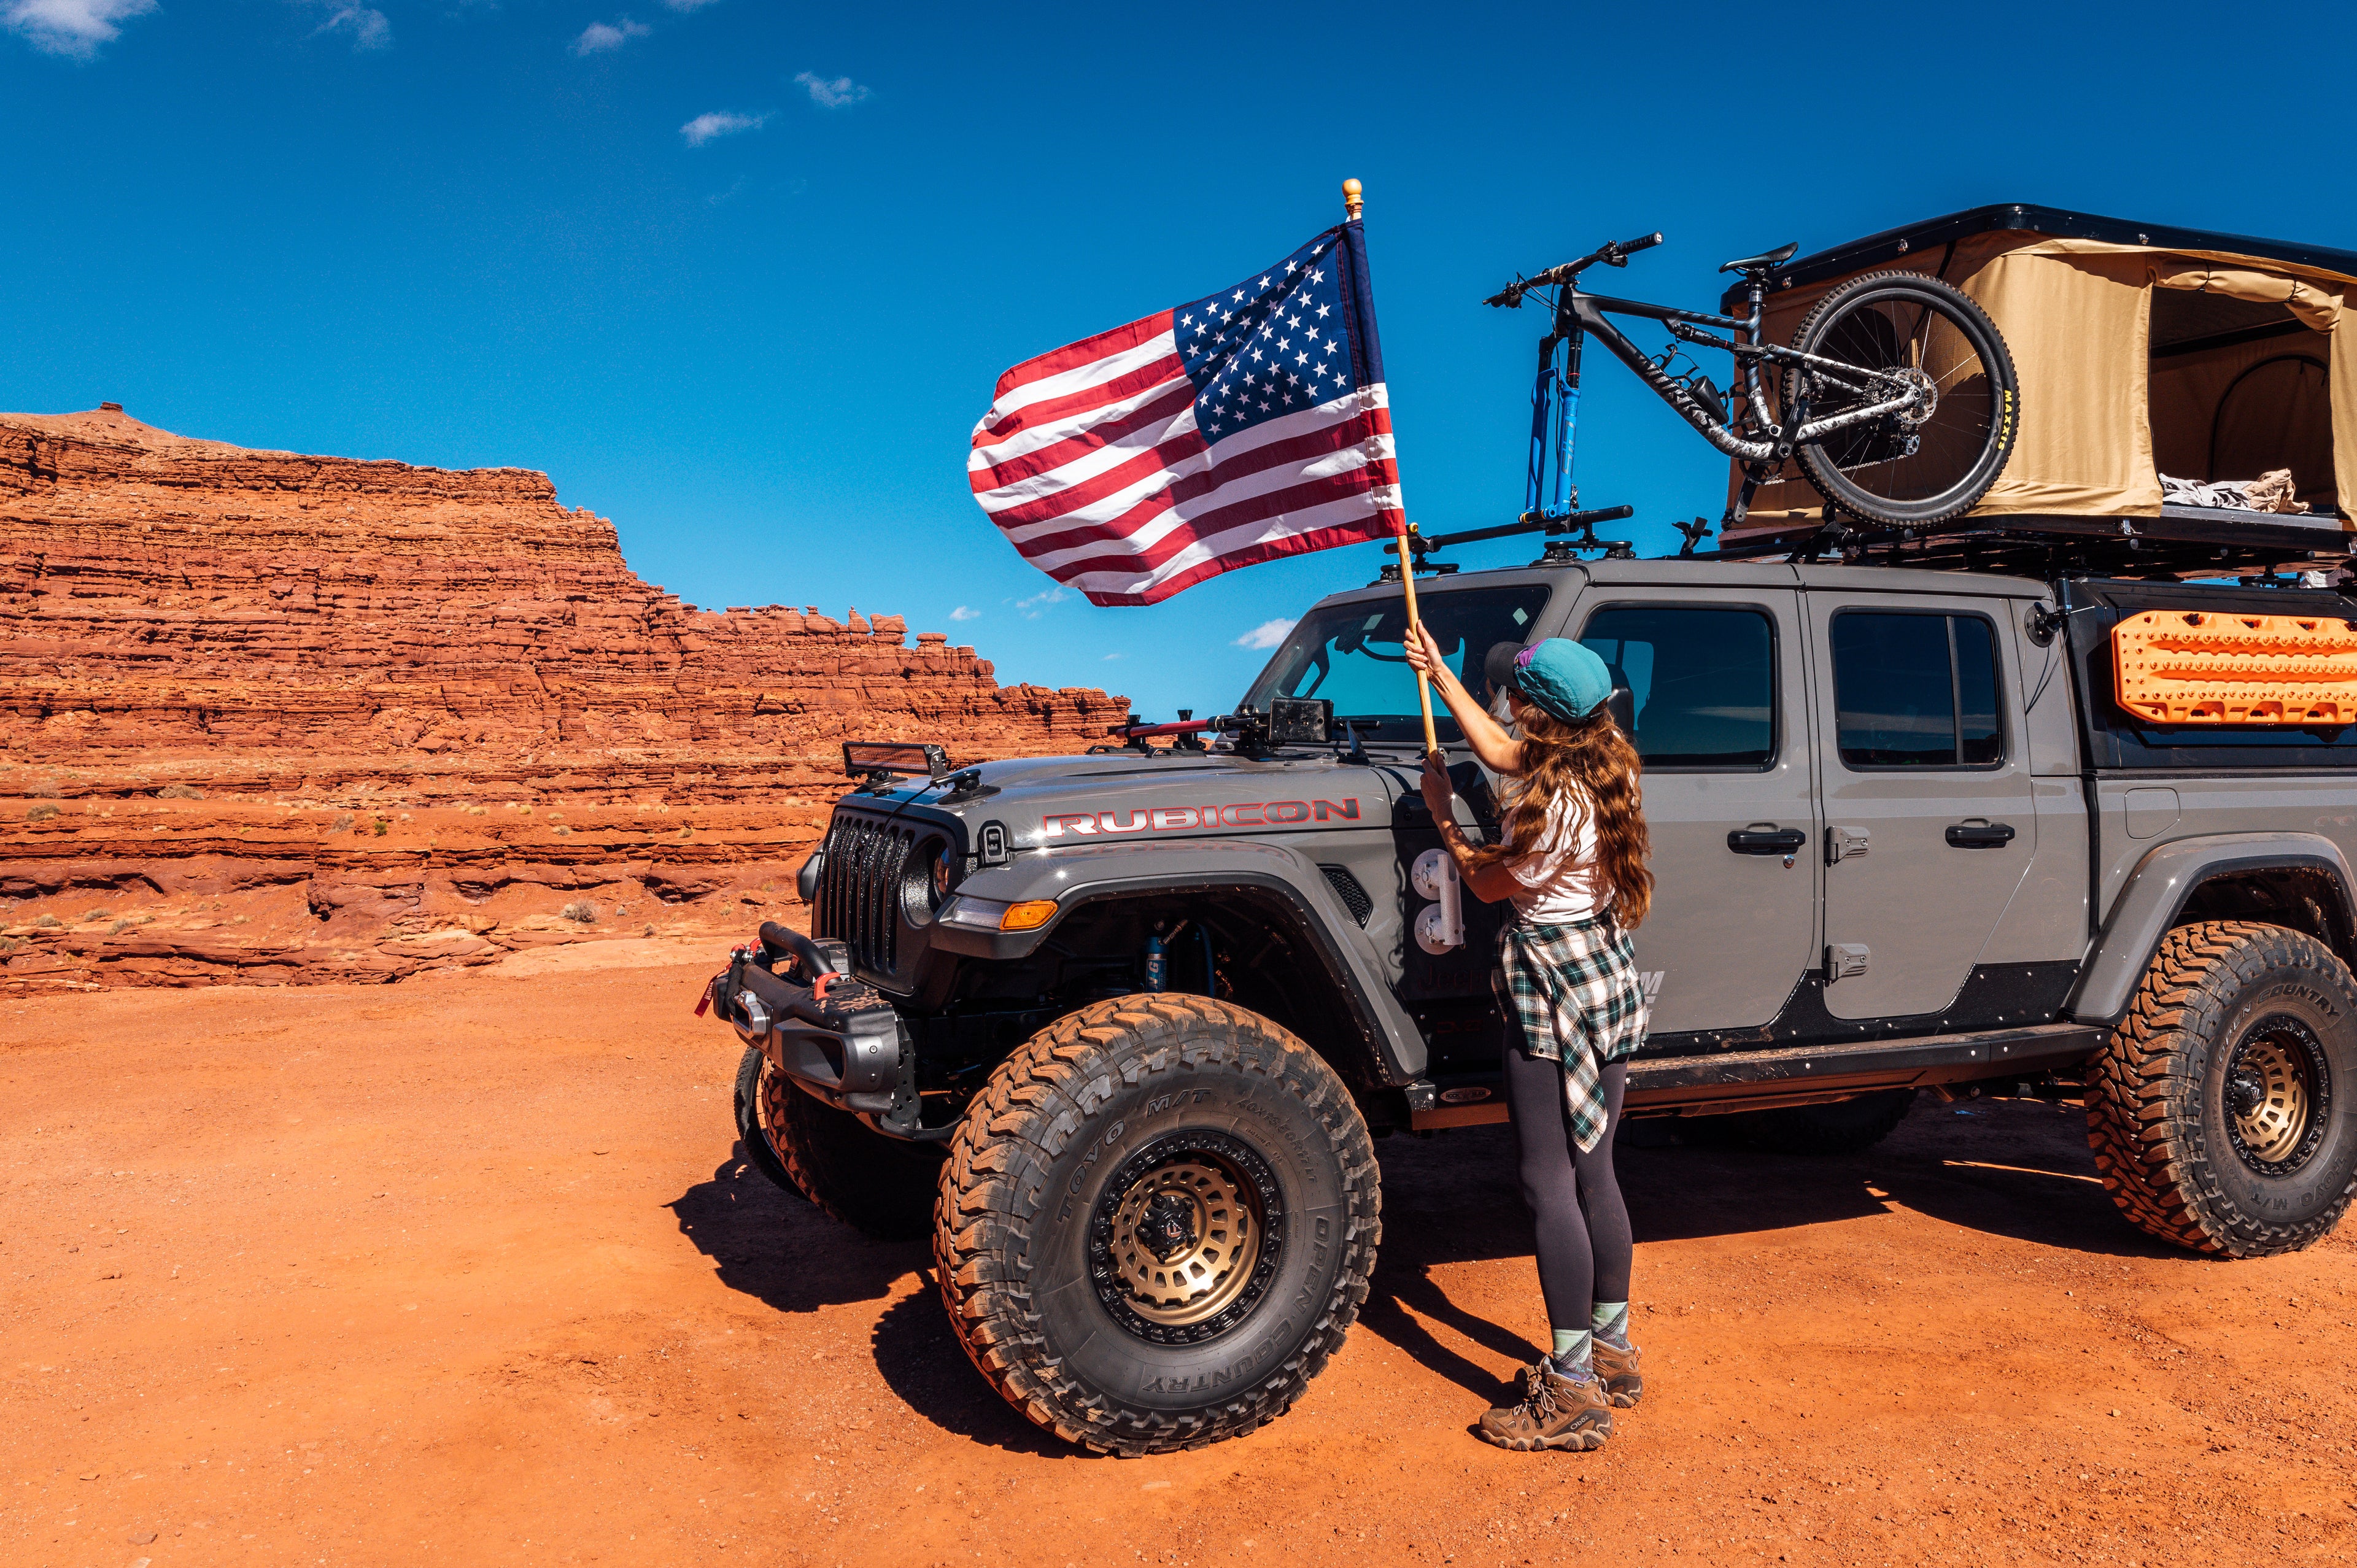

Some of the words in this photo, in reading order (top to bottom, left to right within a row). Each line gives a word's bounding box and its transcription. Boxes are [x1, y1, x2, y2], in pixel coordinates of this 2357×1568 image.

[1997, 389, 2013, 451] MAXXIS
[1042, 798, 1361, 838] RUBICON
[1418, 965, 1482, 993] Jeep
[2218, 1001, 2252, 1064] OPEN
[2258, 984, 2340, 1018] COUNTRY
[1058, 1119, 1125, 1222] TOYO
[1146, 1088, 1211, 1119] M/T
[2299, 1156, 2347, 1207] TOYO
[2249, 1192, 2288, 1210] M/T
[1293, 1216, 1330, 1315] OPEN
[1142, 1319, 1294, 1395] COUNTRY
